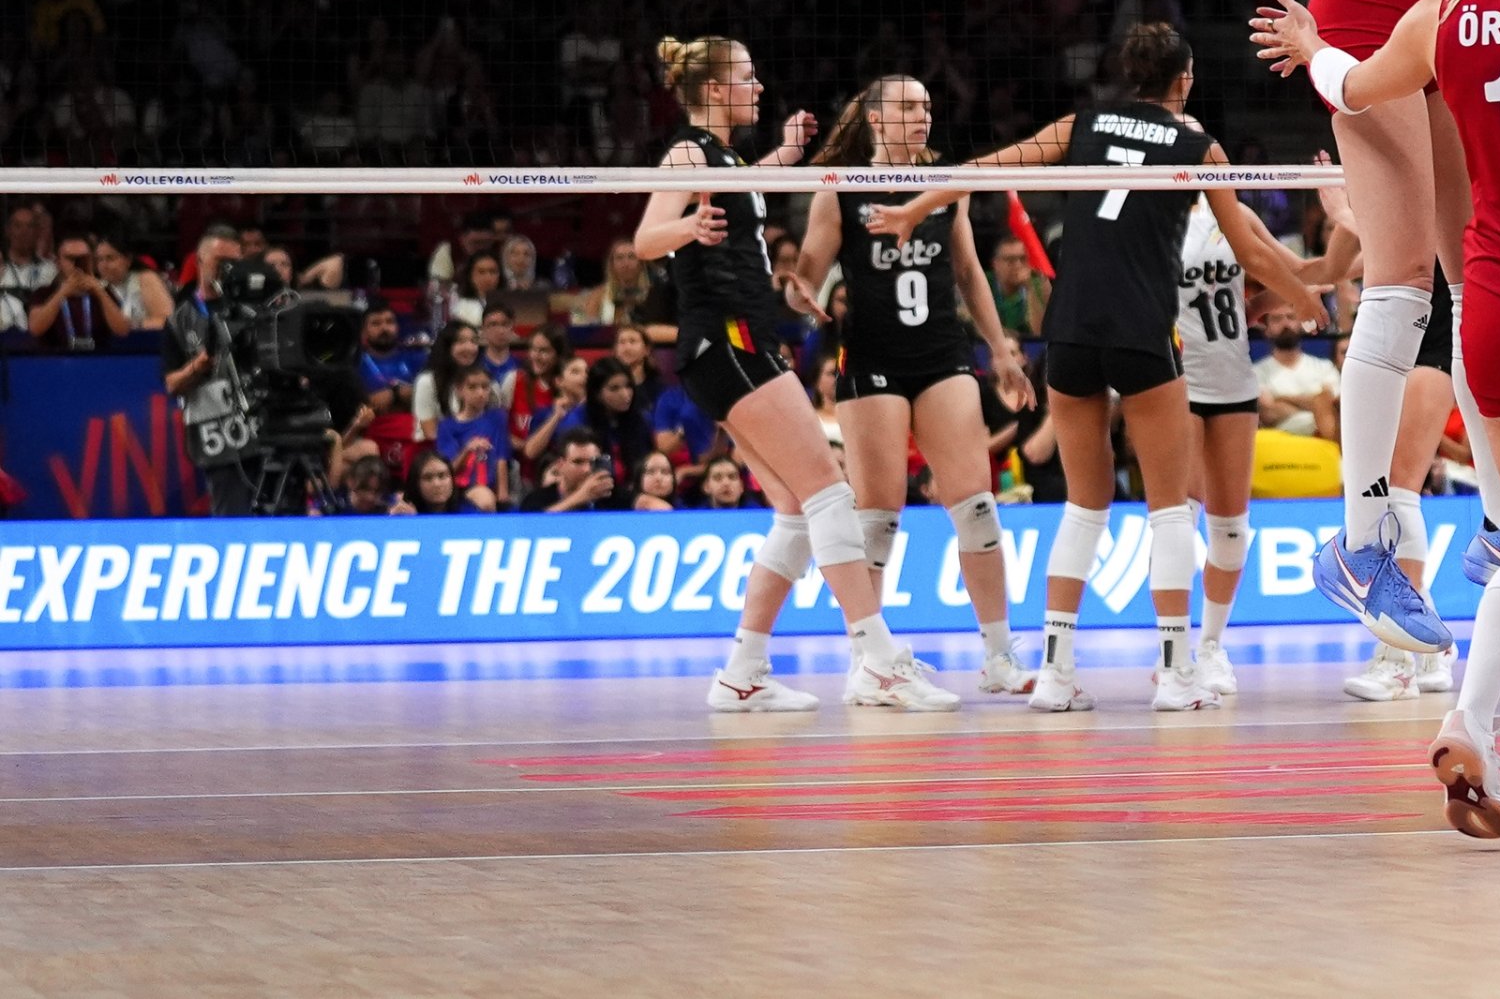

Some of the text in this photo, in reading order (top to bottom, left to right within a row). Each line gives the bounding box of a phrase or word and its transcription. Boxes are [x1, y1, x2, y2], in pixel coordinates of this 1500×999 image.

[125, 175, 208, 185] VOLLEYBALL
[489, 175, 570, 184] VOLLEYBALL
[846, 174, 926, 183] VOLLEYBALL
[1097, 145, 1146, 221] 7
[1197, 172, 1275, 181] VOLLEYBALL
[896, 271, 930, 328] 9
[1189, 287, 1240, 342] 18
[0, 541, 420, 623] EXPERIENCE
[439, 538, 571, 616] THE
[582, 533, 757, 615] 2026
